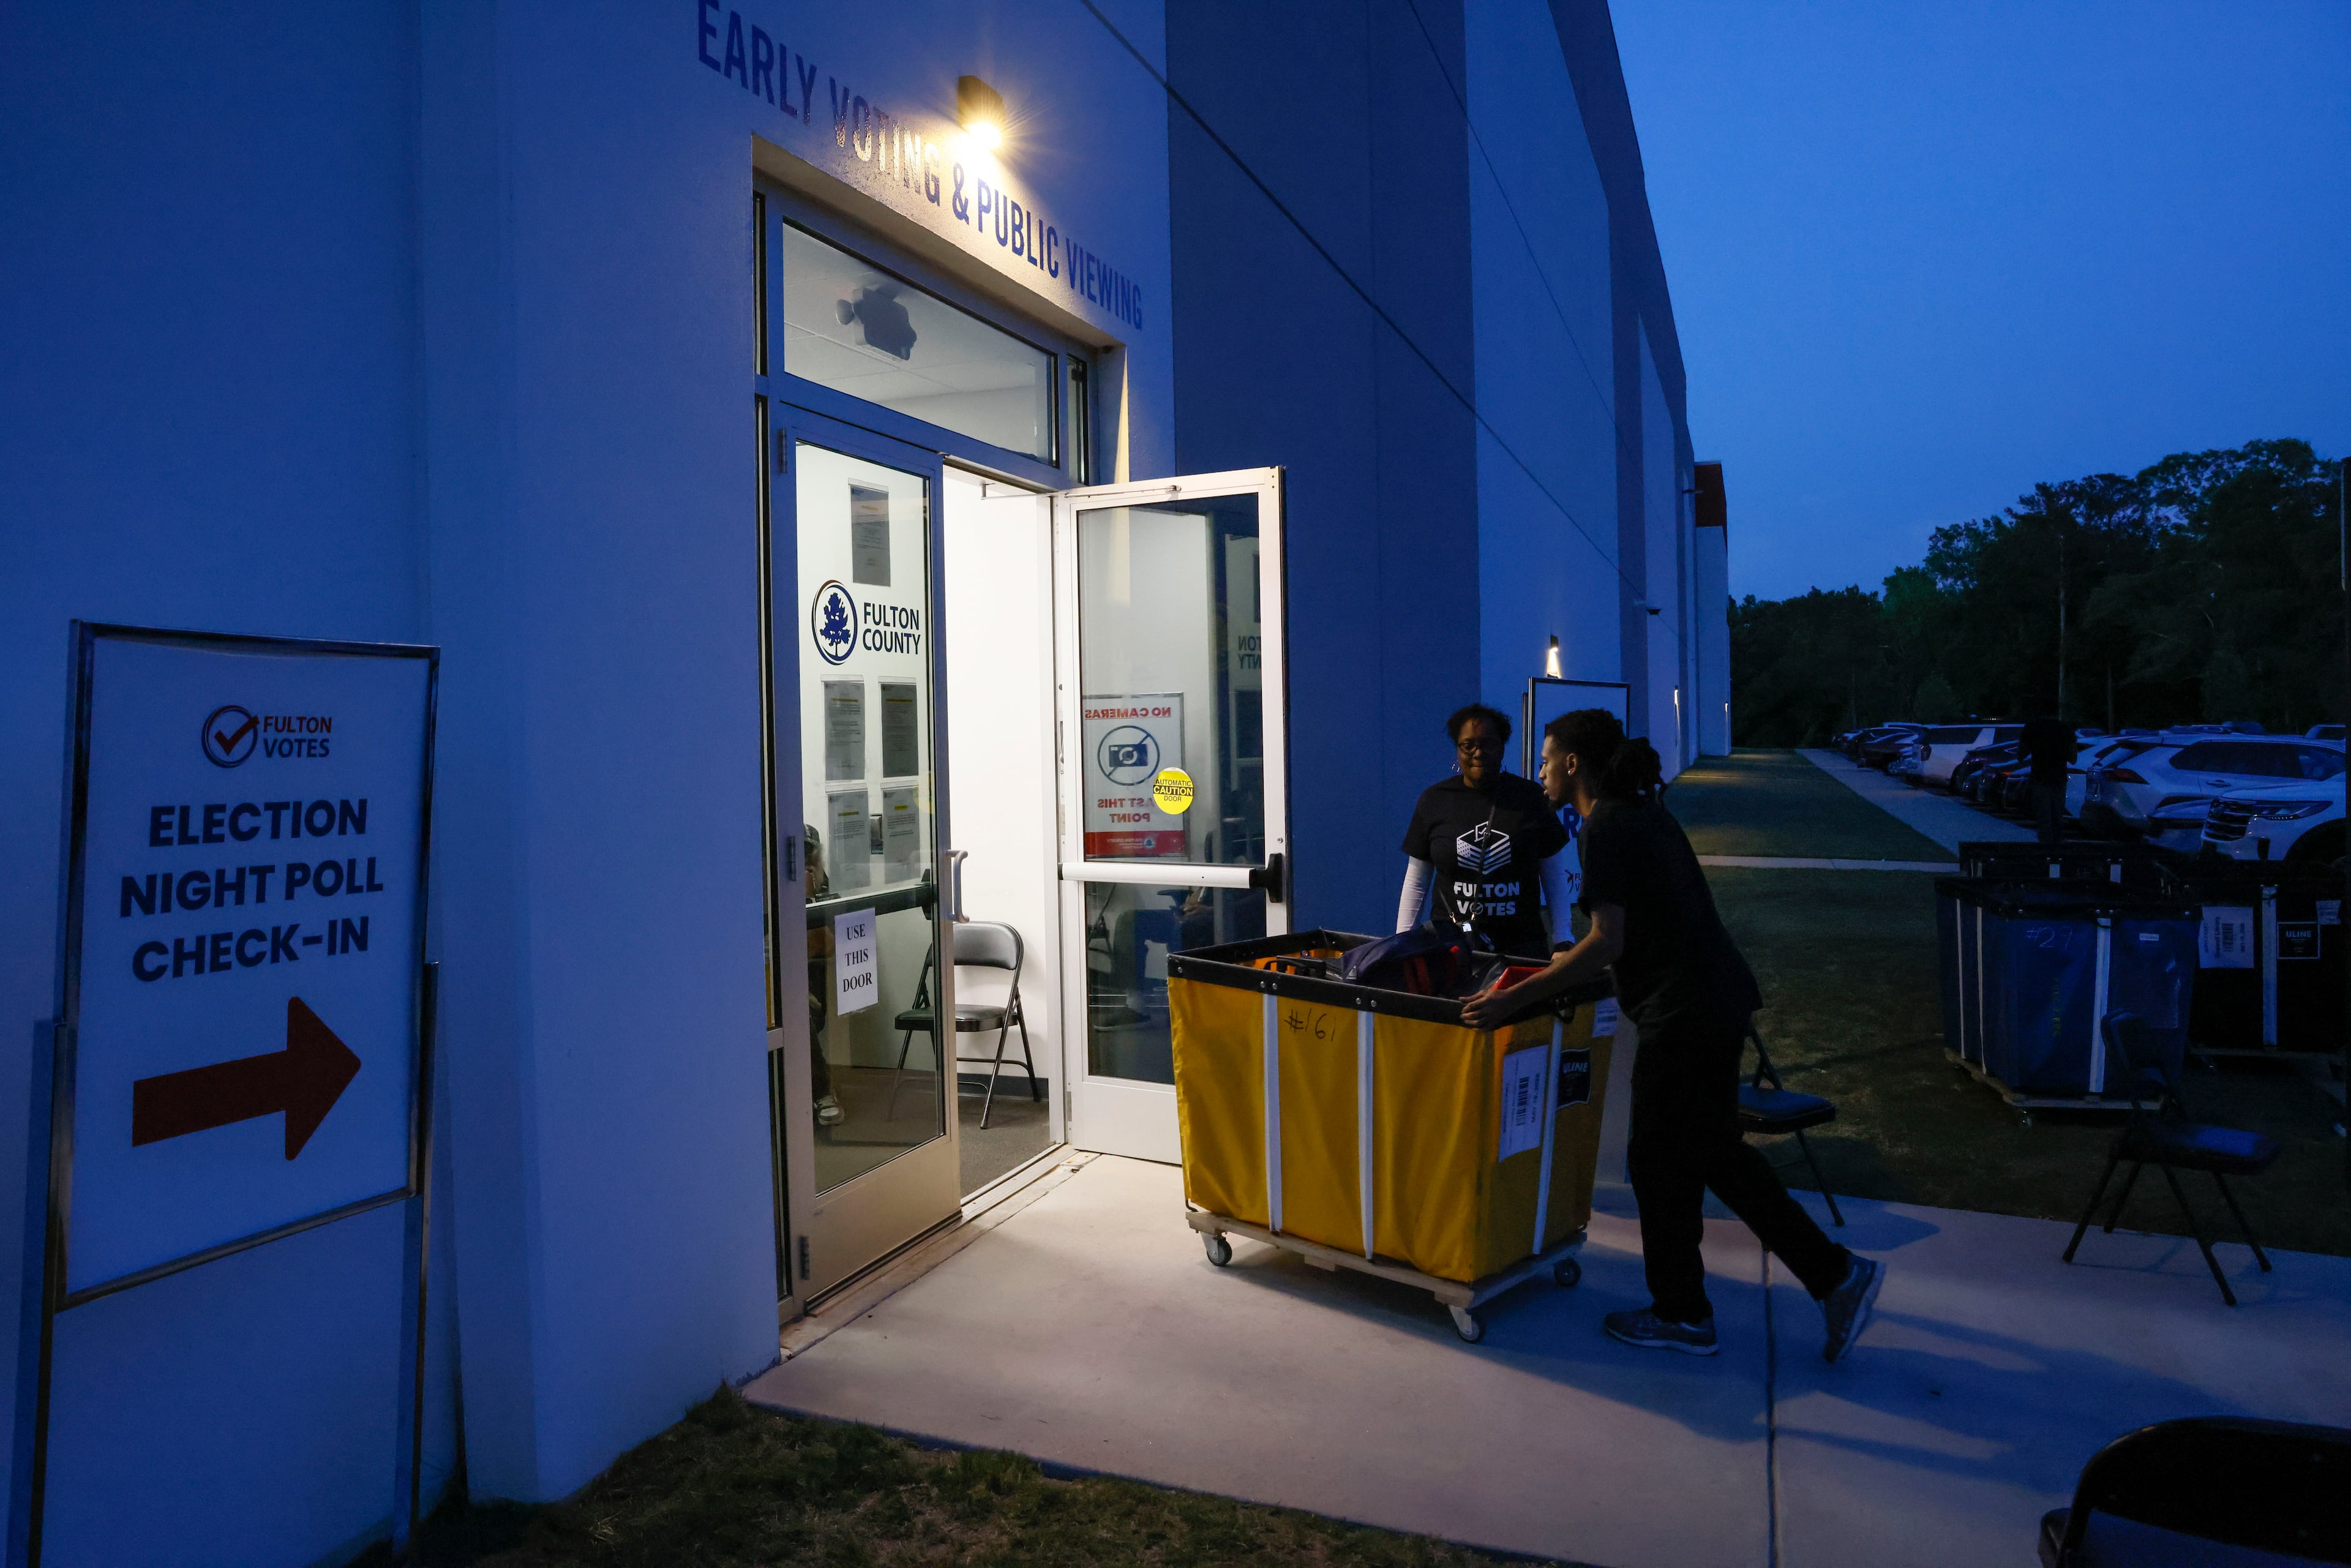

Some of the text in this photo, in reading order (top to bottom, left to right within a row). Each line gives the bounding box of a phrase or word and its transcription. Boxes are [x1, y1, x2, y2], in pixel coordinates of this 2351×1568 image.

[698, 0, 1143, 331] EARLY VOTING & PUBLIC VIEWING
[864, 602, 919, 630] FULTON
[863, 629, 920, 655] COUNTY
[263, 715, 332, 733] FULTON
[263, 738, 330, 759] VOTES
[1153, 787, 1193, 796] CAUTION
[149, 798, 367, 847] ELECTION
[120, 857, 384, 919] NIGHT POLL
[847, 923, 866, 940] USE
[132, 916, 370, 983] CHECK-IN
[845, 948, 869, 966] THIS
[843, 972, 872, 992] DOOR
[1562, 1062, 1589, 1074] ULINE
